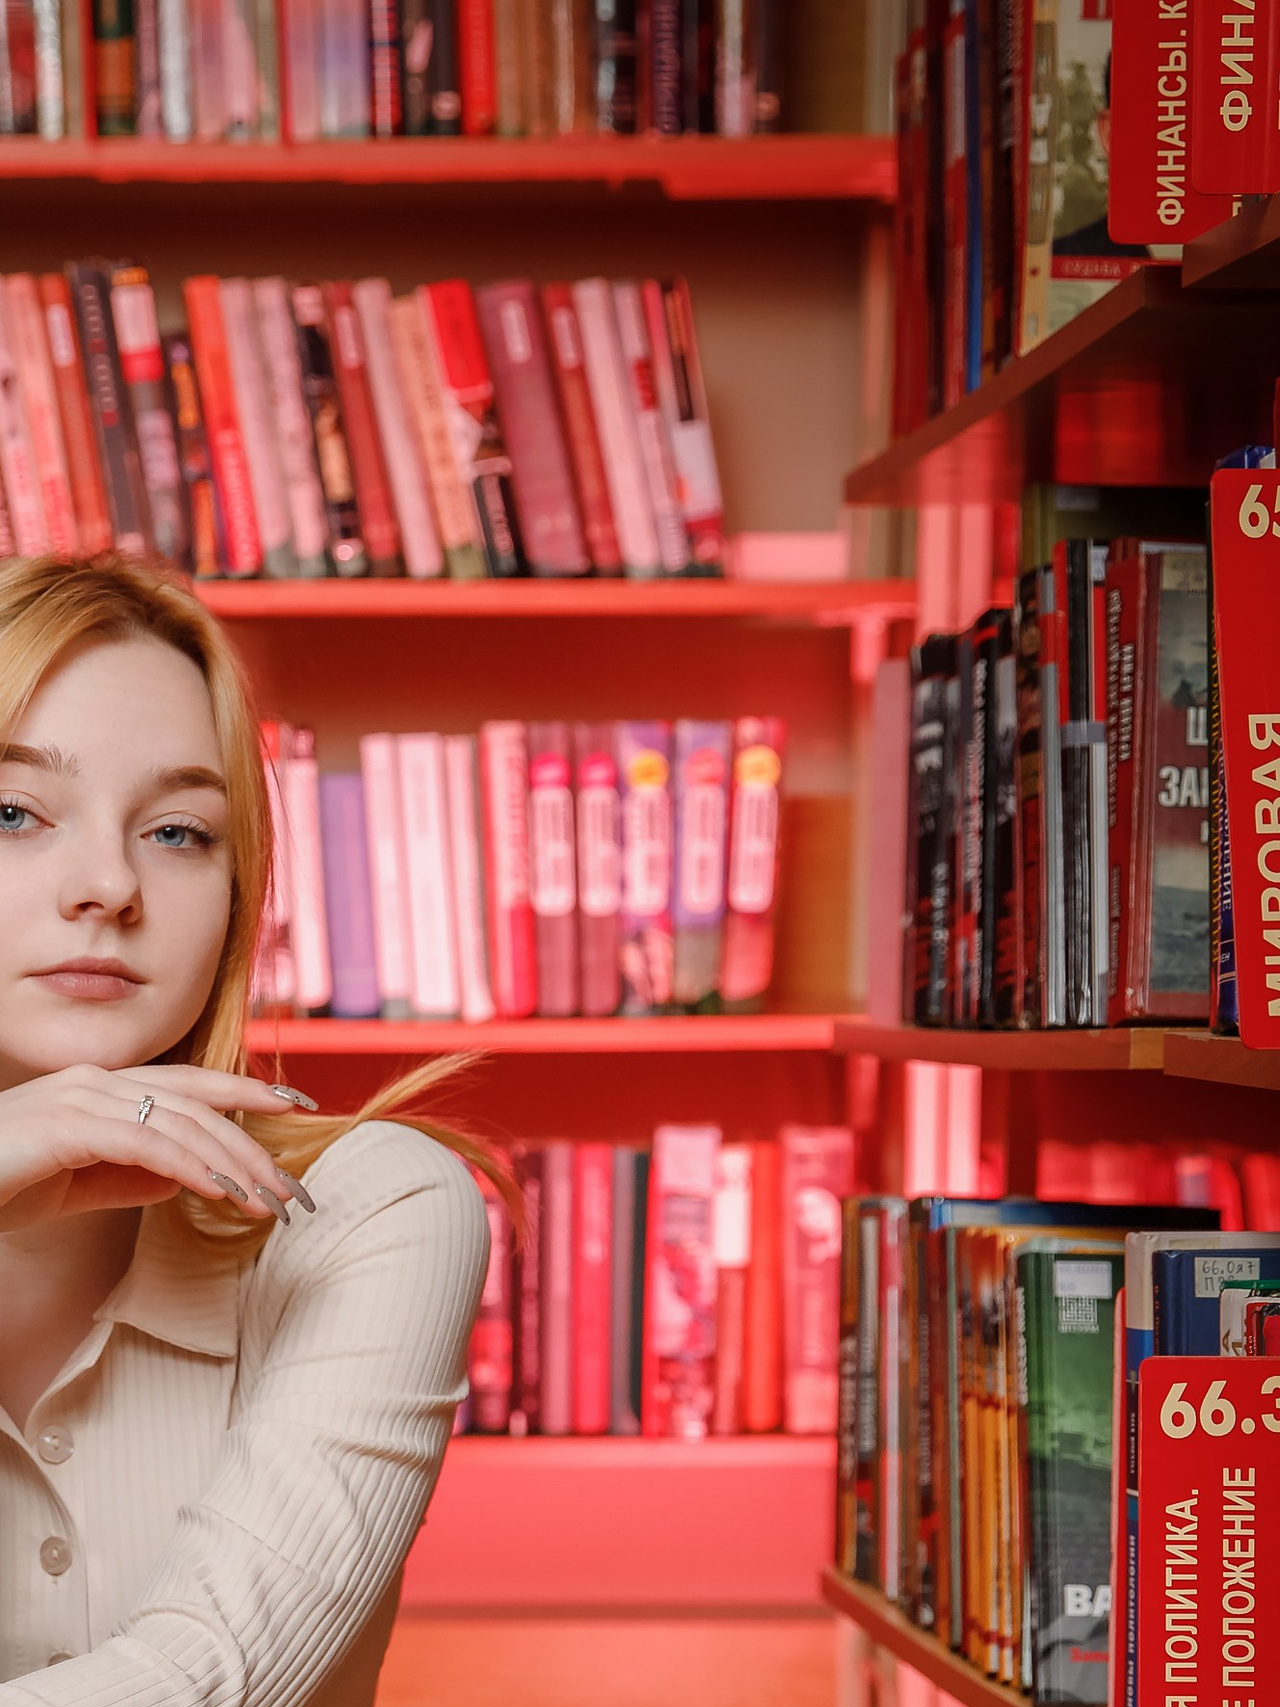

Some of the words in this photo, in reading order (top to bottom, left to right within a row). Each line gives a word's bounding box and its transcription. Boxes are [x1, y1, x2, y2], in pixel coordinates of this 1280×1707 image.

[1156, 29, 1188, 226] ФИНАНСЫ.
[1238, 484, 1280, 539] 6
[1158, 765, 1209, 808] ЗА
[1159, 1375, 1280, 1440] 66.3
[1165, 1488, 1199, 1683] ПОЛИТИКА.
[1223, 1466, 1257, 1688] ПОЛОЖЕНИЕ
